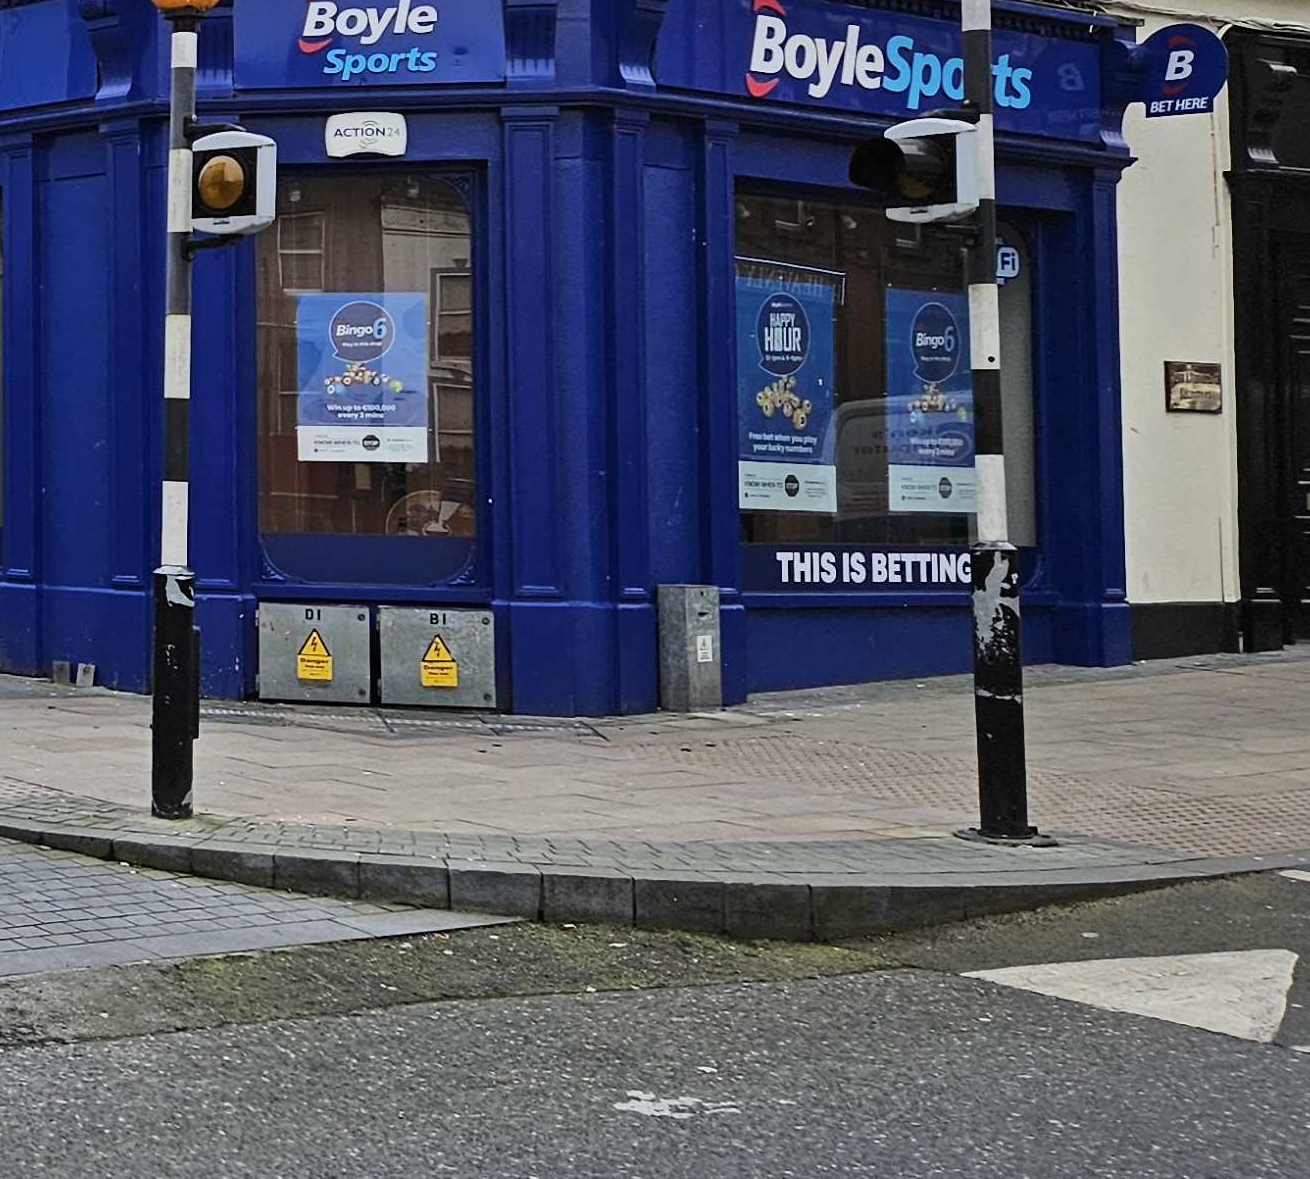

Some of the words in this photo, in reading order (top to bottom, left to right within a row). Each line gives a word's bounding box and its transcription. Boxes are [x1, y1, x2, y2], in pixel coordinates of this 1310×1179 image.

[323, 46, 437, 81] Sports
[750, 14, 1033, 110] BoyleSpots
[1165, 50, 1194, 81] B
[1150, 100, 1173, 113] BET
[1175, 97, 1209, 111] HERE
[1001, 252, 1015, 270] Fi
[770, 313, 795, 327] HAPPY
[764, 327, 802, 352] HOUR
[776, 551, 836, 584] THIS
[842, 551, 869, 584] IS
